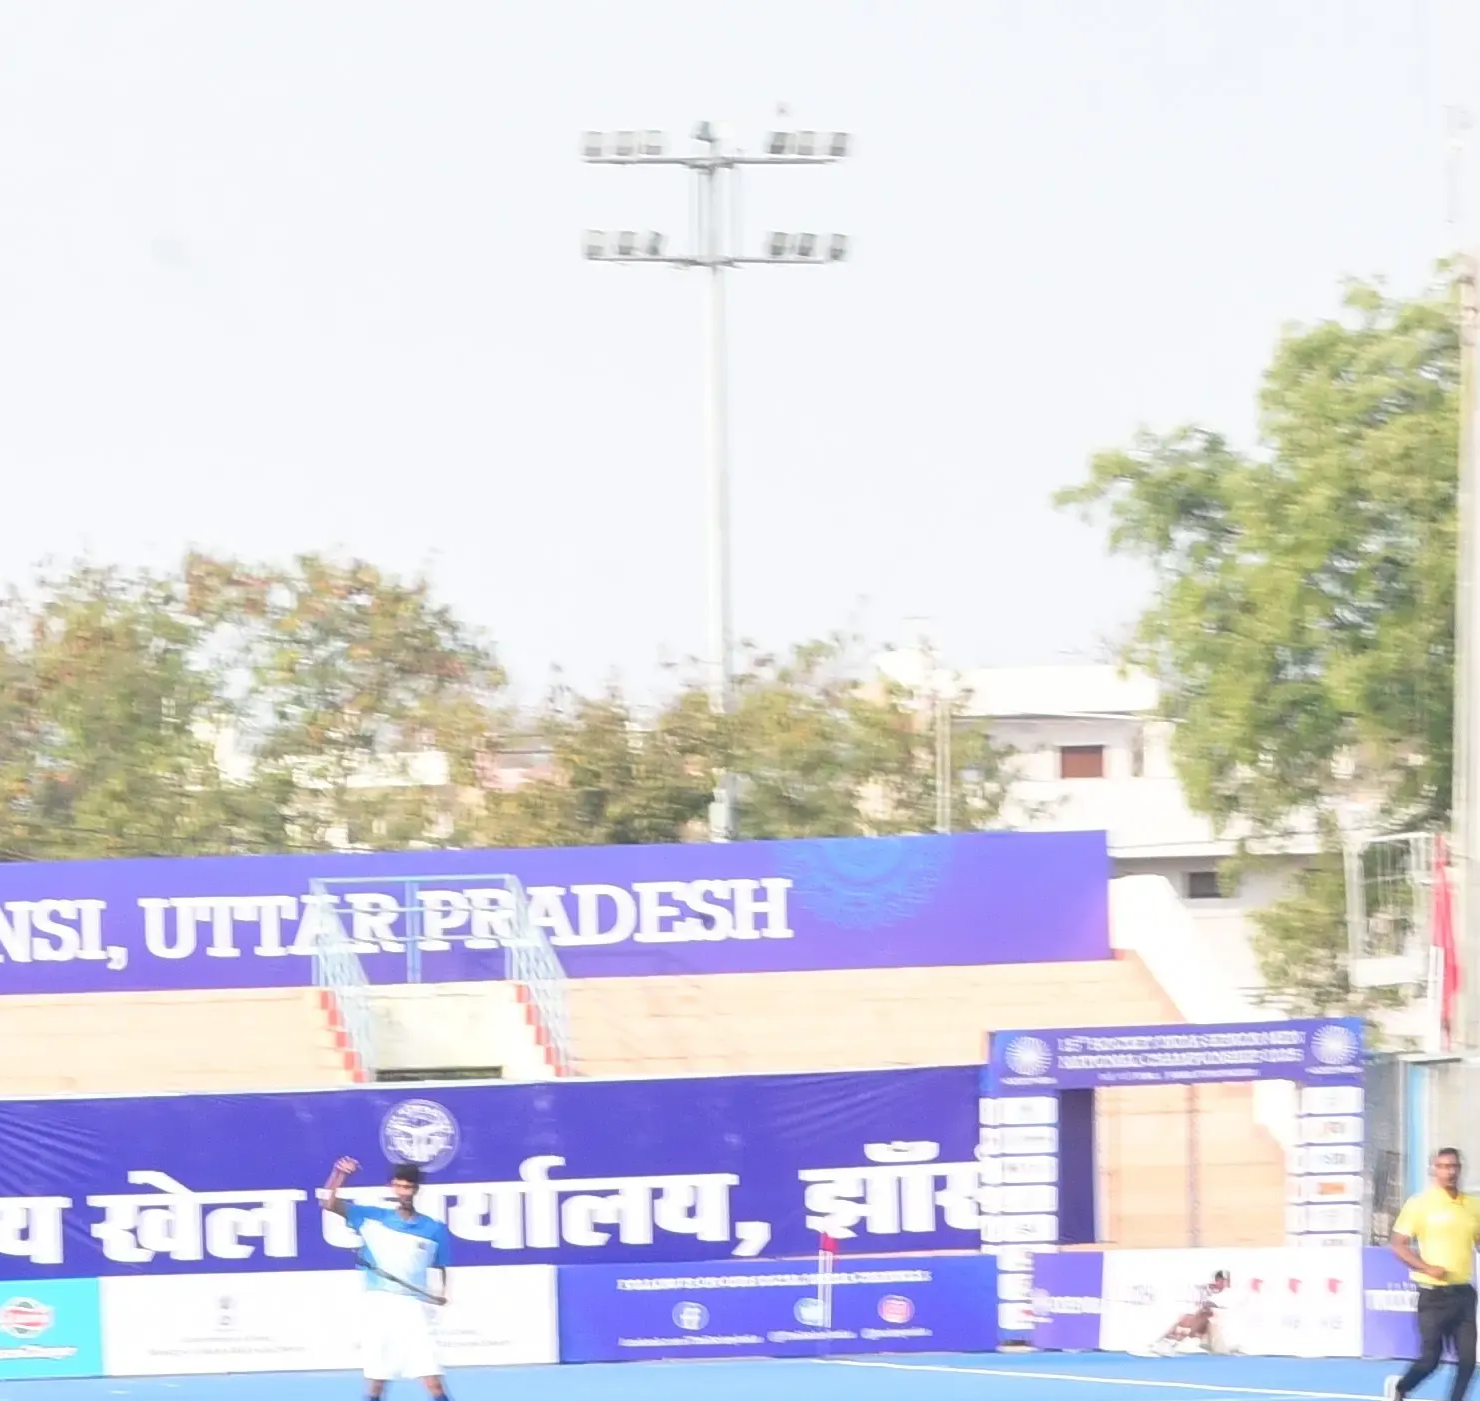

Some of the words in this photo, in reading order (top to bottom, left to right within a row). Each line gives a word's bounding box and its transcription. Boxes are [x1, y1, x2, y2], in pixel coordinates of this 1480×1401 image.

[140, 891, 405, 959] UTTAR
[417, 877, 794, 951] PRADESH
[86, 1170, 307, 1263] खेल
